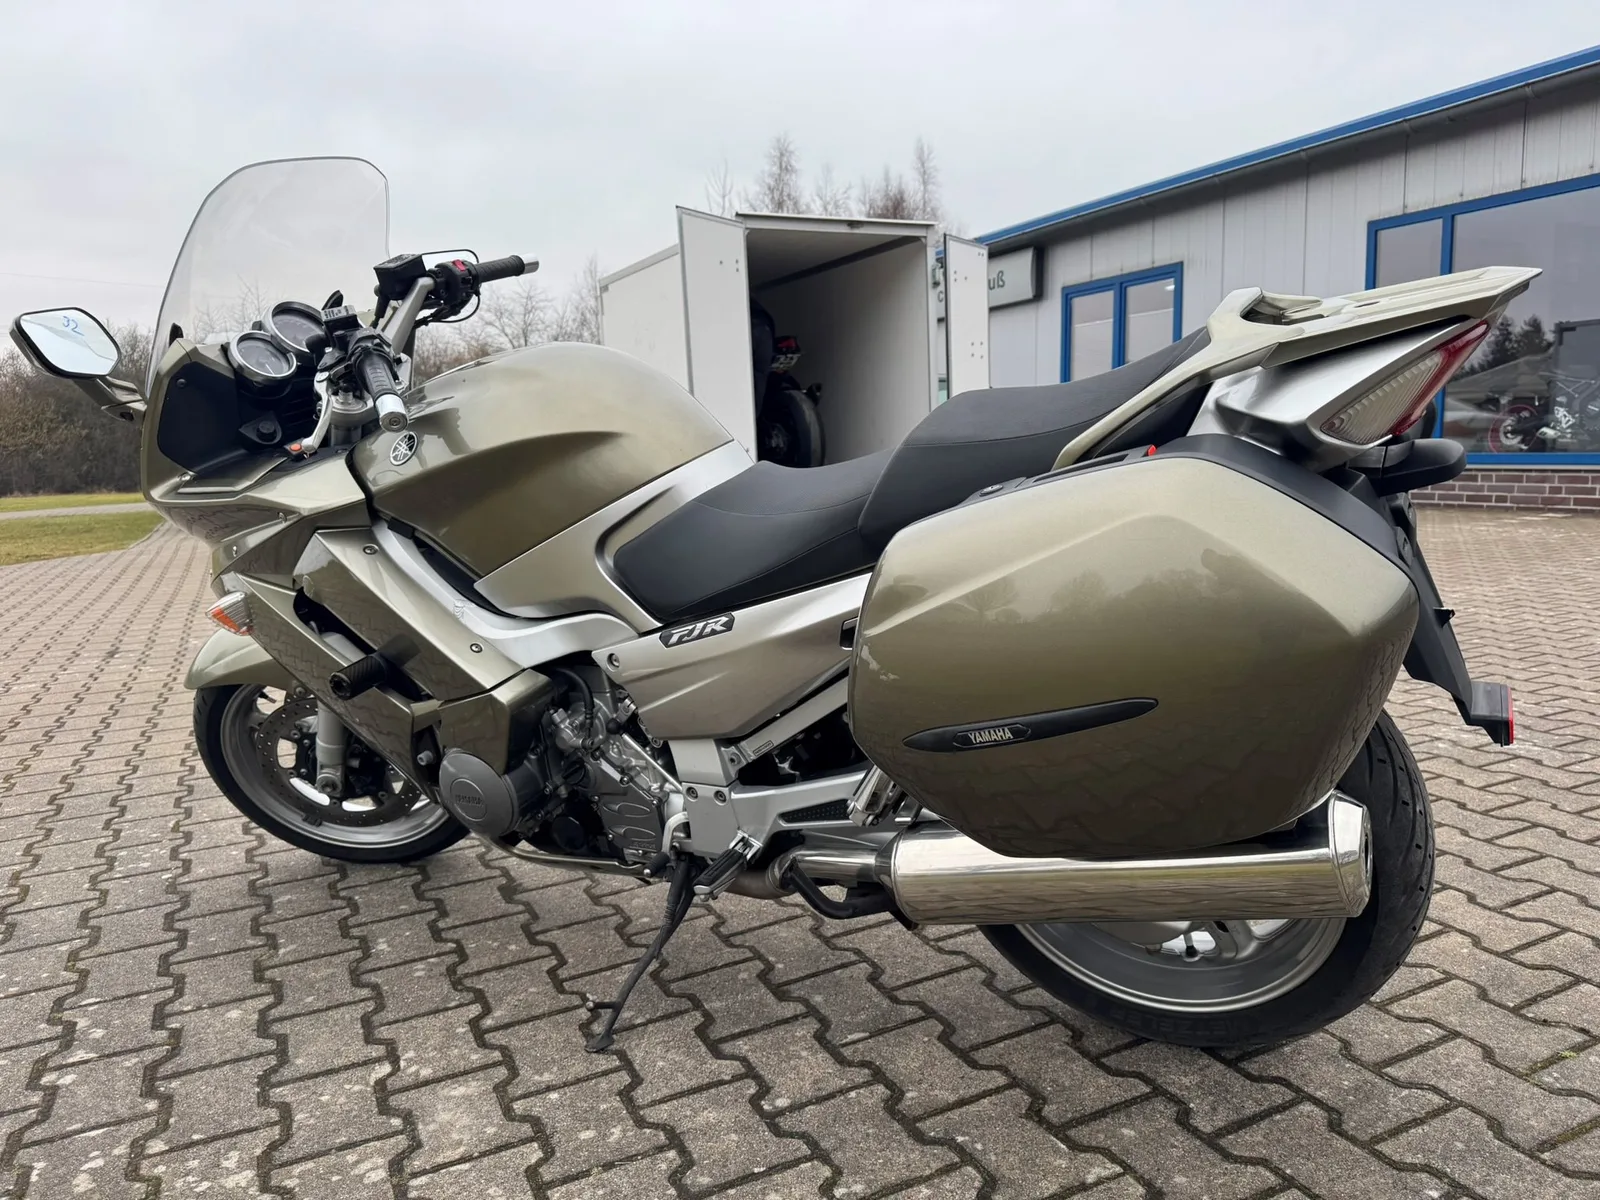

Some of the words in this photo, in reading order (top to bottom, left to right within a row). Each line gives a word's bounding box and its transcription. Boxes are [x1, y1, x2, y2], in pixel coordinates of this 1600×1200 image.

[62, 315, 85, 337] 32
[667, 616, 729, 645] FJR
[968, 727, 1014, 744] YAMAHA
